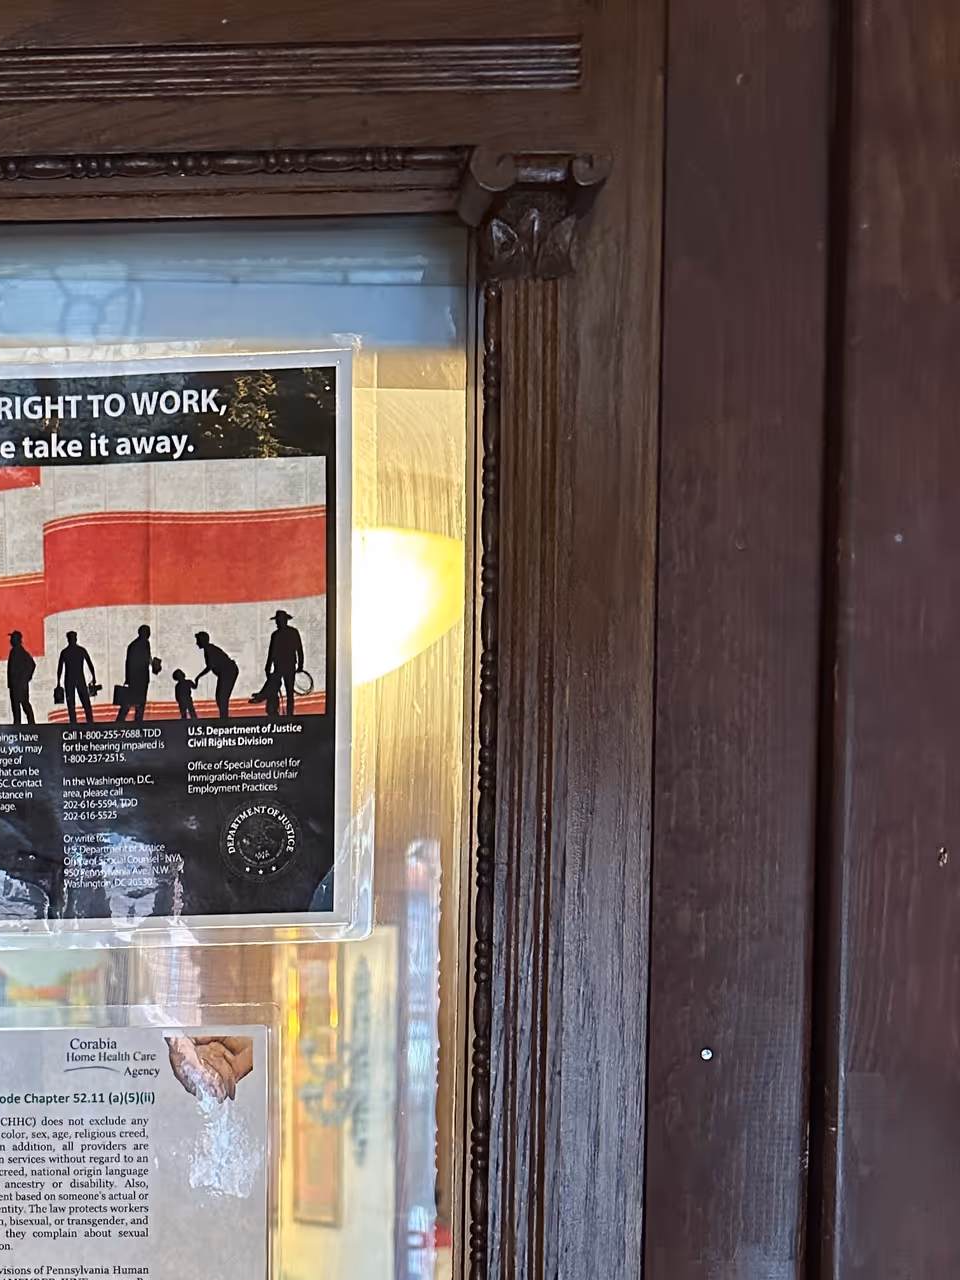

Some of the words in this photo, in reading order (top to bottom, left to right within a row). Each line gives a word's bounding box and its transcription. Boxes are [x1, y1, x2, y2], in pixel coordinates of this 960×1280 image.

[86, 393, 125, 417] TO
[131, 388, 227, 417] WORK,
[21, 433, 82, 458] take
[90, 432, 108, 456] it
[115, 435, 194, 458] away.
[62, 731, 77, 740] Call
[142, 728, 161, 737] TDD
[187, 726, 204, 735] U.S.
[206, 725, 260, 736] Department
[261, 723, 271, 733] of
[271, 723, 302, 732] Justice
[62, 742, 73, 752] for
[74, 742, 88, 751] the
[89, 742, 120, 752] hearing
[121, 740, 157, 751] impaired
[158, 740, 164, 748] is
[187, 737, 206, 747] Civil
[208, 737, 236, 748] Rights
[237, 736, 273, 745] Division
[63, 752, 126, 763] 1-800-237-2515.
[187, 760, 212, 770] Office
[213, 760, 223, 769] of
[223, 759, 252, 770] Special
[253, 758, 287, 768] Counsel
[288, 757, 300, 767] for
[62, 777, 71, 786] In
[71, 777, 85, 786] the
[85, 776, 135, 786] Washington,
[187, 770, 271, 783] Immigration-Related
[272, 769, 298, 779] Unfair
[62, 790, 81, 798] area,
[82, 788, 108, 798] please
[109, 787, 123, 796] call
[187, 784, 240, 794] Employment
[241, 782, 277, 791] Practices
[119, 798, 138, 808] TDD
[63, 810, 117, 820] 202-616-5525
[227, 806, 267, 854] DEPARTMENT
[267, 807, 280, 818] OF
[278, 814, 296, 853] JUSTICE
[69, 1037, 116, 1050] Corabia
[66, 1052, 95, 1062] Home
[98, 1051, 130, 1061] Health
[132, 1051, 156, 1061] Care
[123, 1067, 160, 1078] Agency
[23, 1093, 70, 1105] Chapter
[73, 1092, 104, 1103] 52.11
[108, 1091, 155, 1105] (a)(5)(ii)
[33, 1265, 44, 1274] of
[46, 1265, 109, 1276] Pennsylvania
[112, 1265, 149, 1274] Human
